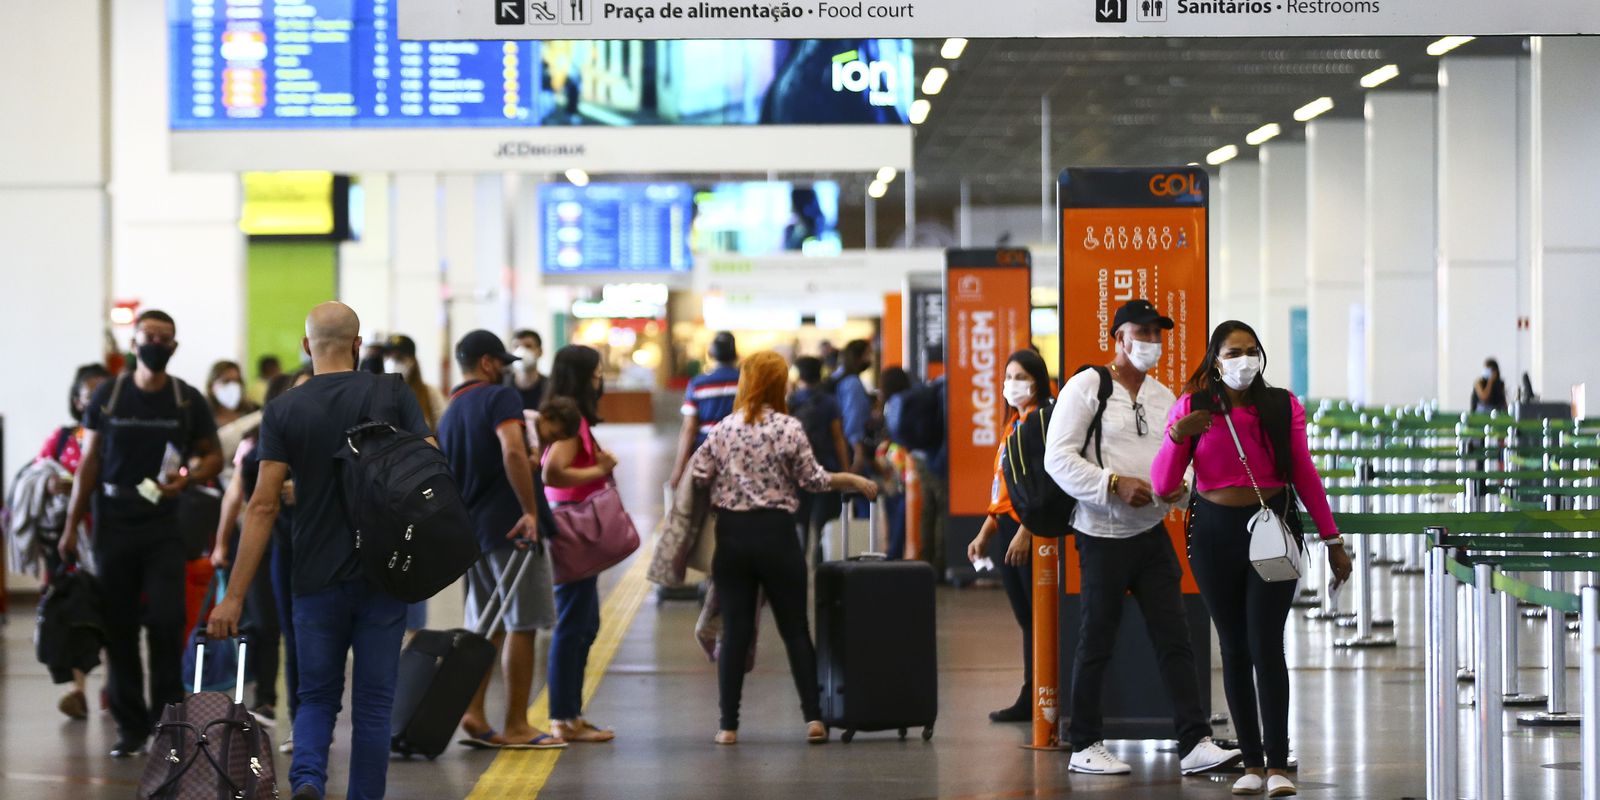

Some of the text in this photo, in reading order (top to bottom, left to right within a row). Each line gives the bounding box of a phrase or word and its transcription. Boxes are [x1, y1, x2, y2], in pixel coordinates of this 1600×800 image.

[603, 1, 915, 22] Praça de alimentação Food court
[1287, 0, 1380, 14] Restrooms
[1149, 173, 1202, 197] GOL
[1115, 269, 1132, 301] LEI
[1137, 268, 1149, 300] pecial
[1097, 268, 1108, 352] atendimento
[971, 310, 996, 447] BAGAGEM
[1038, 687, 1057, 696] Pis
